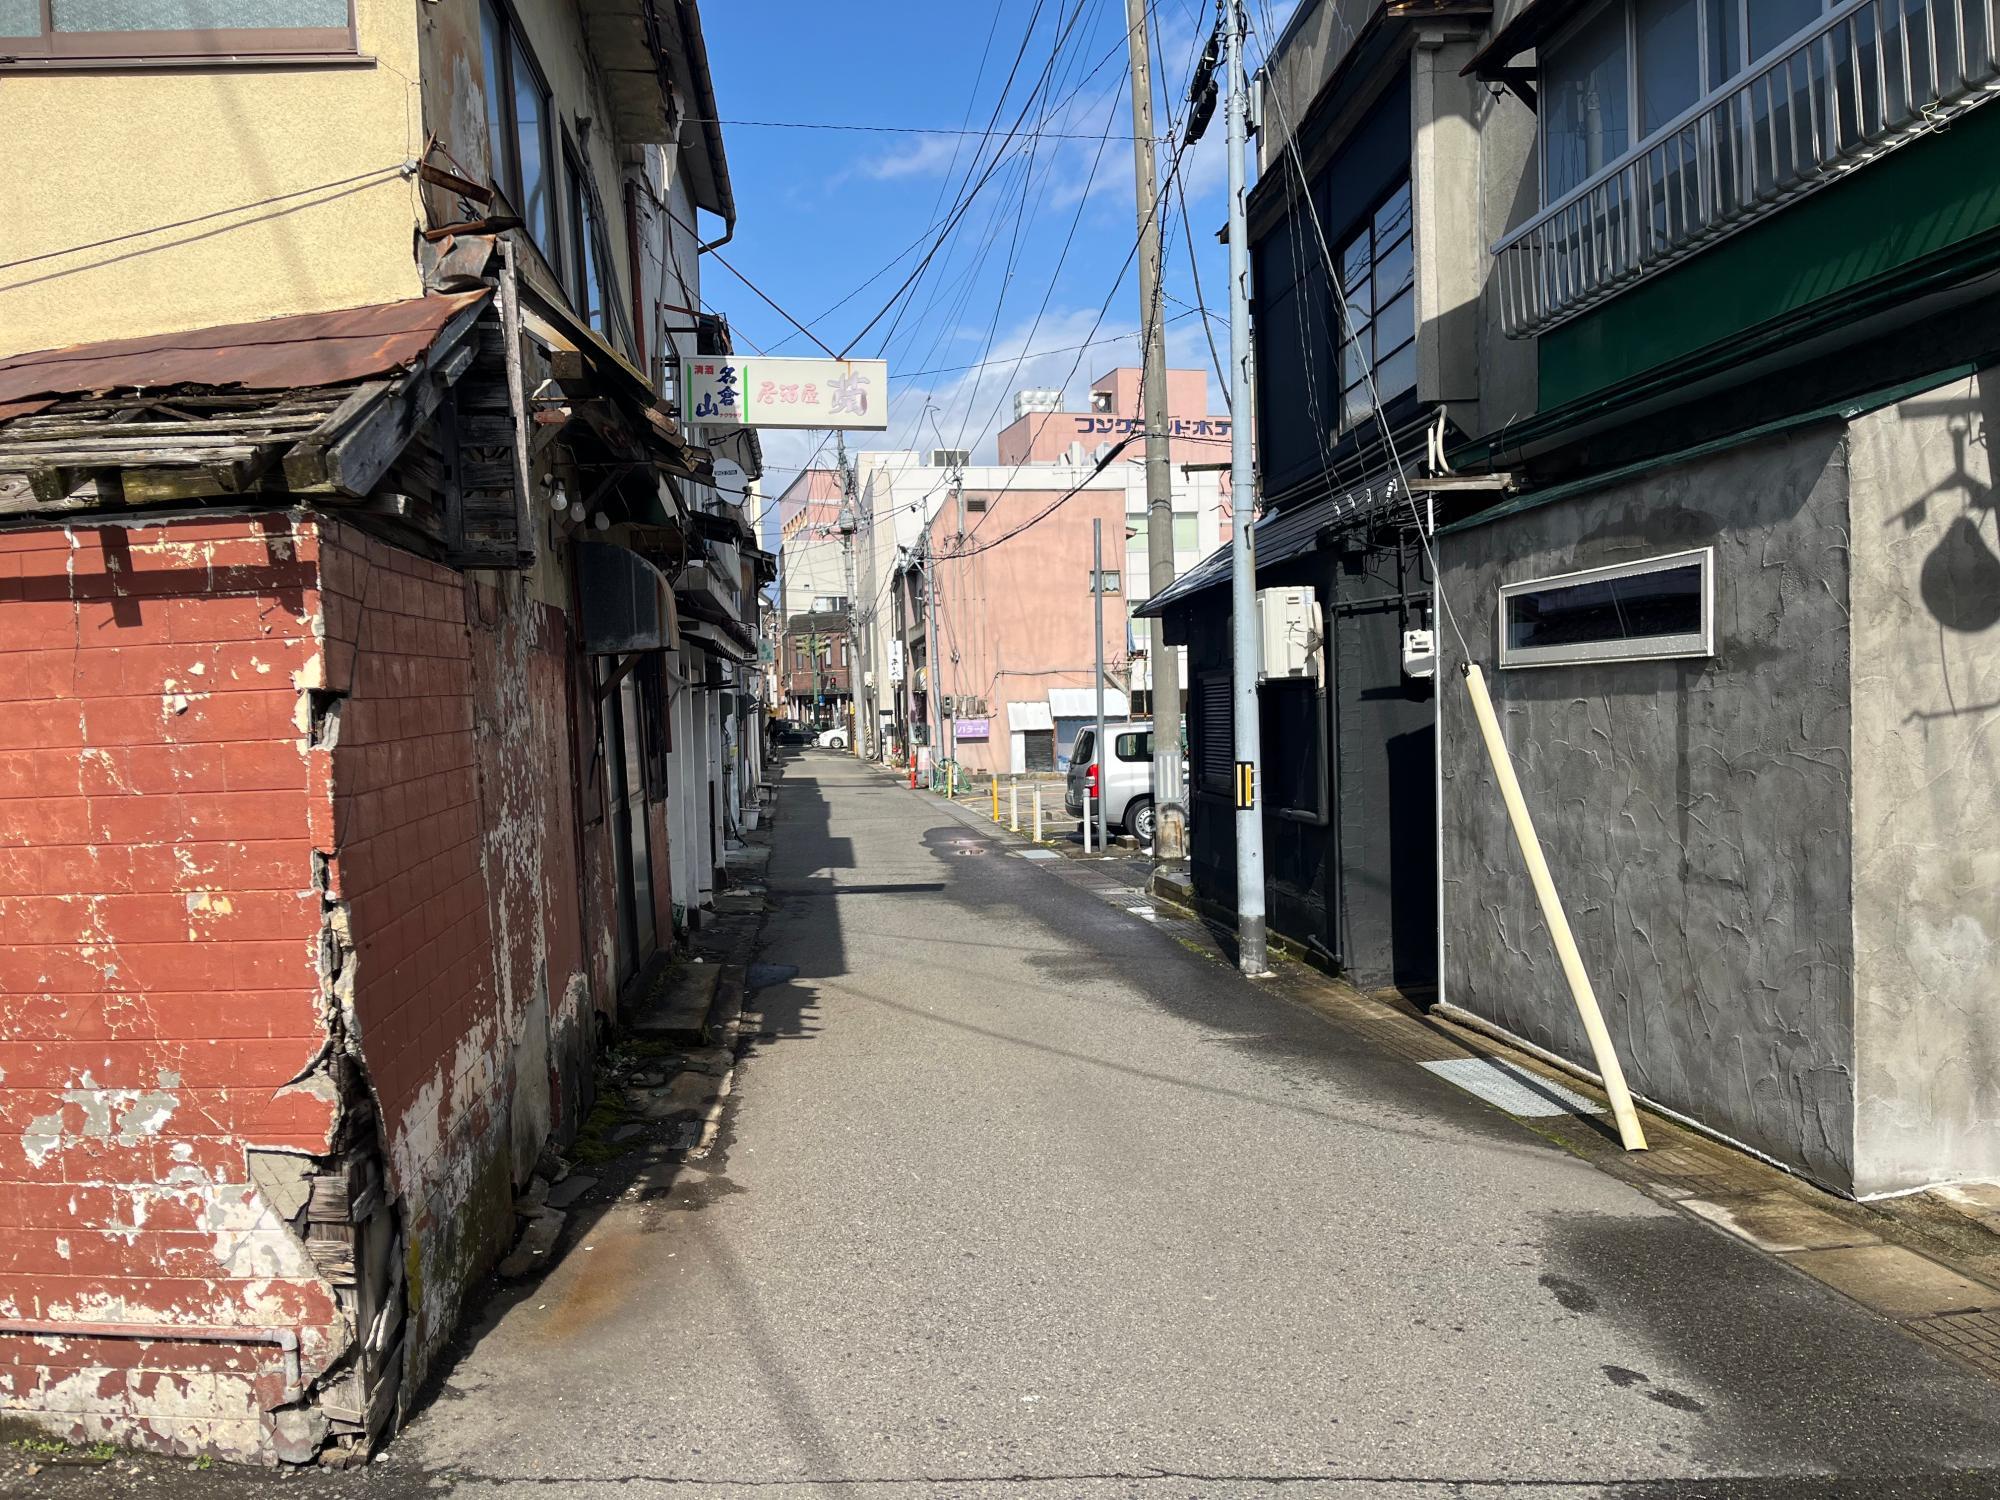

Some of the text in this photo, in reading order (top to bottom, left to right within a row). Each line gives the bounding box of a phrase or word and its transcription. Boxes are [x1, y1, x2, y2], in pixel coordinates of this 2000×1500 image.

[694, 364, 714, 375] 清酒
[757, 381, 820, 405] 居酒屋
